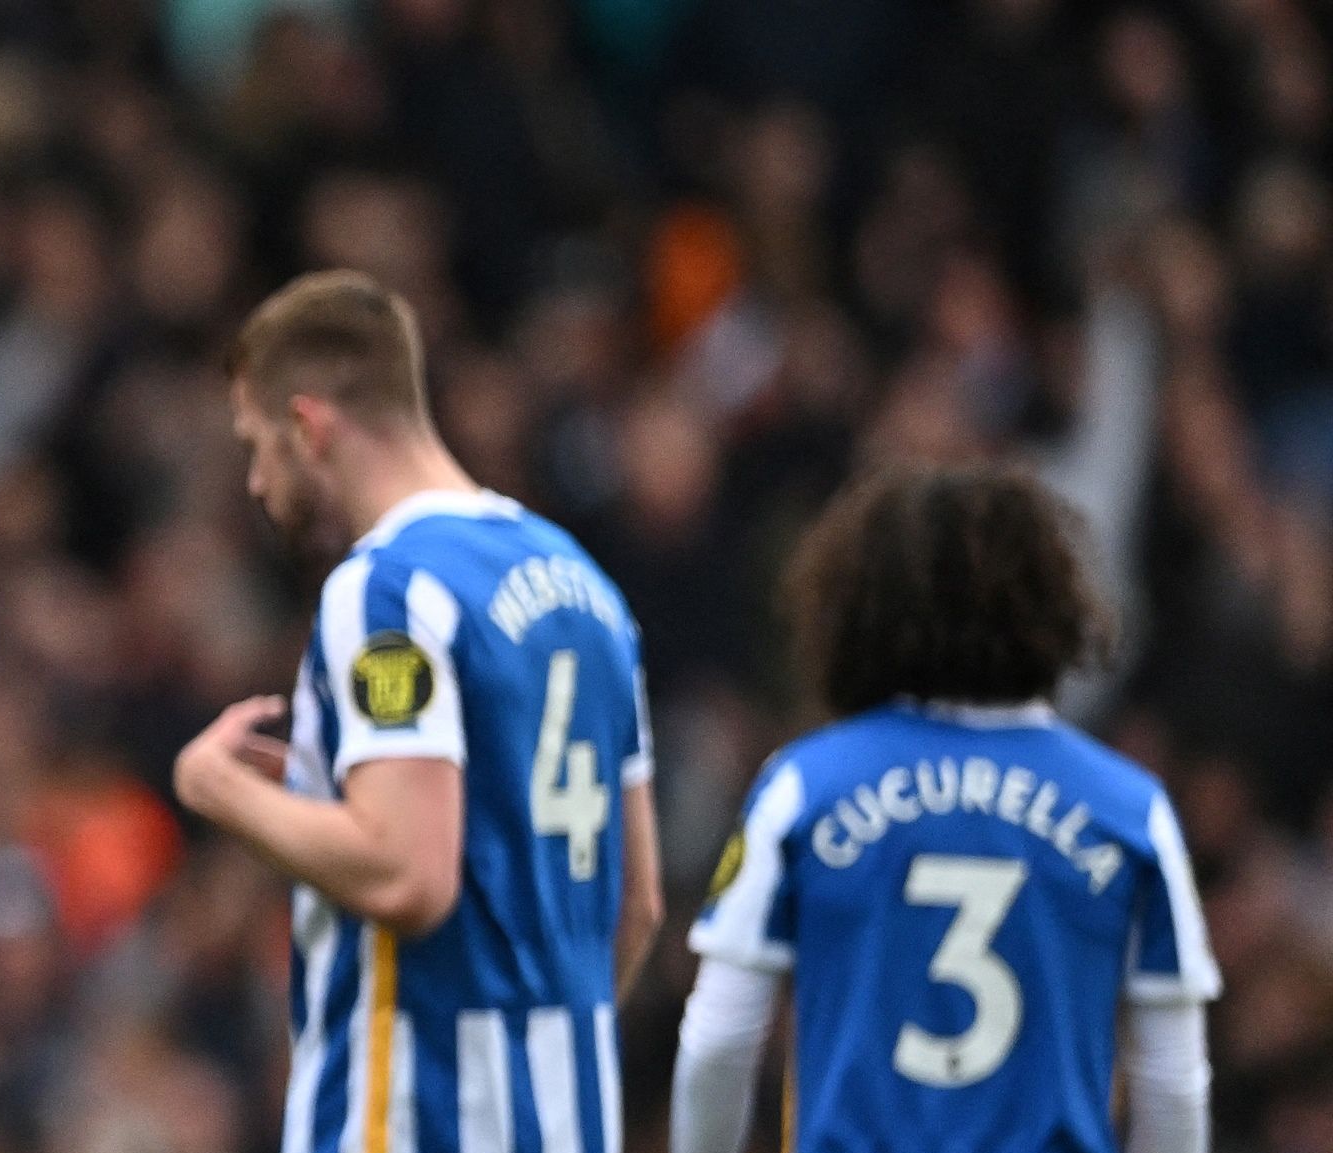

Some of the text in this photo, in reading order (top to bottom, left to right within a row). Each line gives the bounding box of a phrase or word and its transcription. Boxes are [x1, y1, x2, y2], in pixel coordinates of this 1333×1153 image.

[529, 648, 609, 882] 4
[811, 755, 1124, 896] CUCURELLA
[891, 852, 1028, 1088] 3
